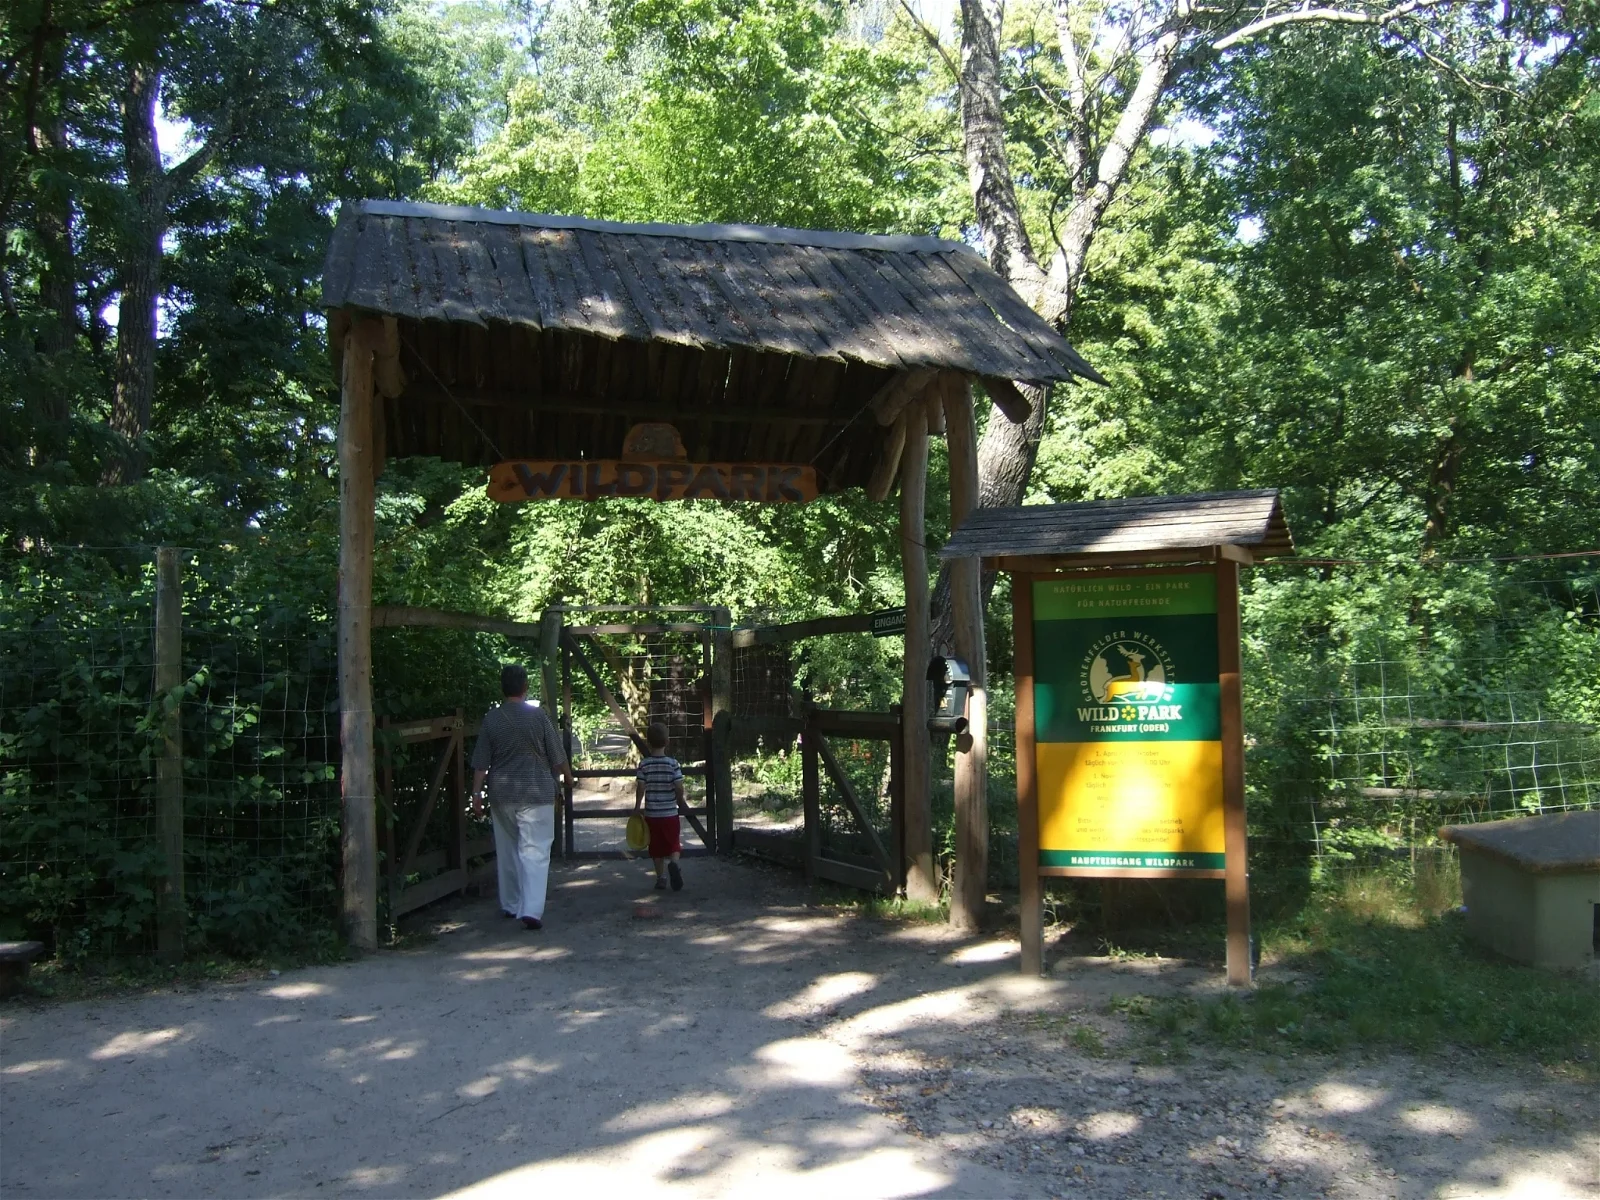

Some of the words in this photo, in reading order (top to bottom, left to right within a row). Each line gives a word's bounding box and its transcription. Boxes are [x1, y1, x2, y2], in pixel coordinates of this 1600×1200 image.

[512, 463, 804, 501] WILDPARK
[1053, 584, 1104, 594] NATÜRLICH
[1108, 584, 1132, 592] WILD
[1145, 583, 1161, 591] EIN
[1166, 581, 1191, 590] PARK
[1077, 599, 1094, 608] FÜR
[1098, 598, 1171, 607] NATURFREUNDE
[1077, 706, 1120, 721] WILD
[1137, 705, 1182, 720] PARK
[1090, 724, 1137, 733] FRANKFURT
[1139, 723, 1169, 733] (ODER)
[1085, 759, 1105, 767] täglich
[1086, 782, 1106, 790] täglich
[1071, 857, 1142, 866] HAUPTEINGANG
[1145, 858, 1195, 867] WILDPARK
